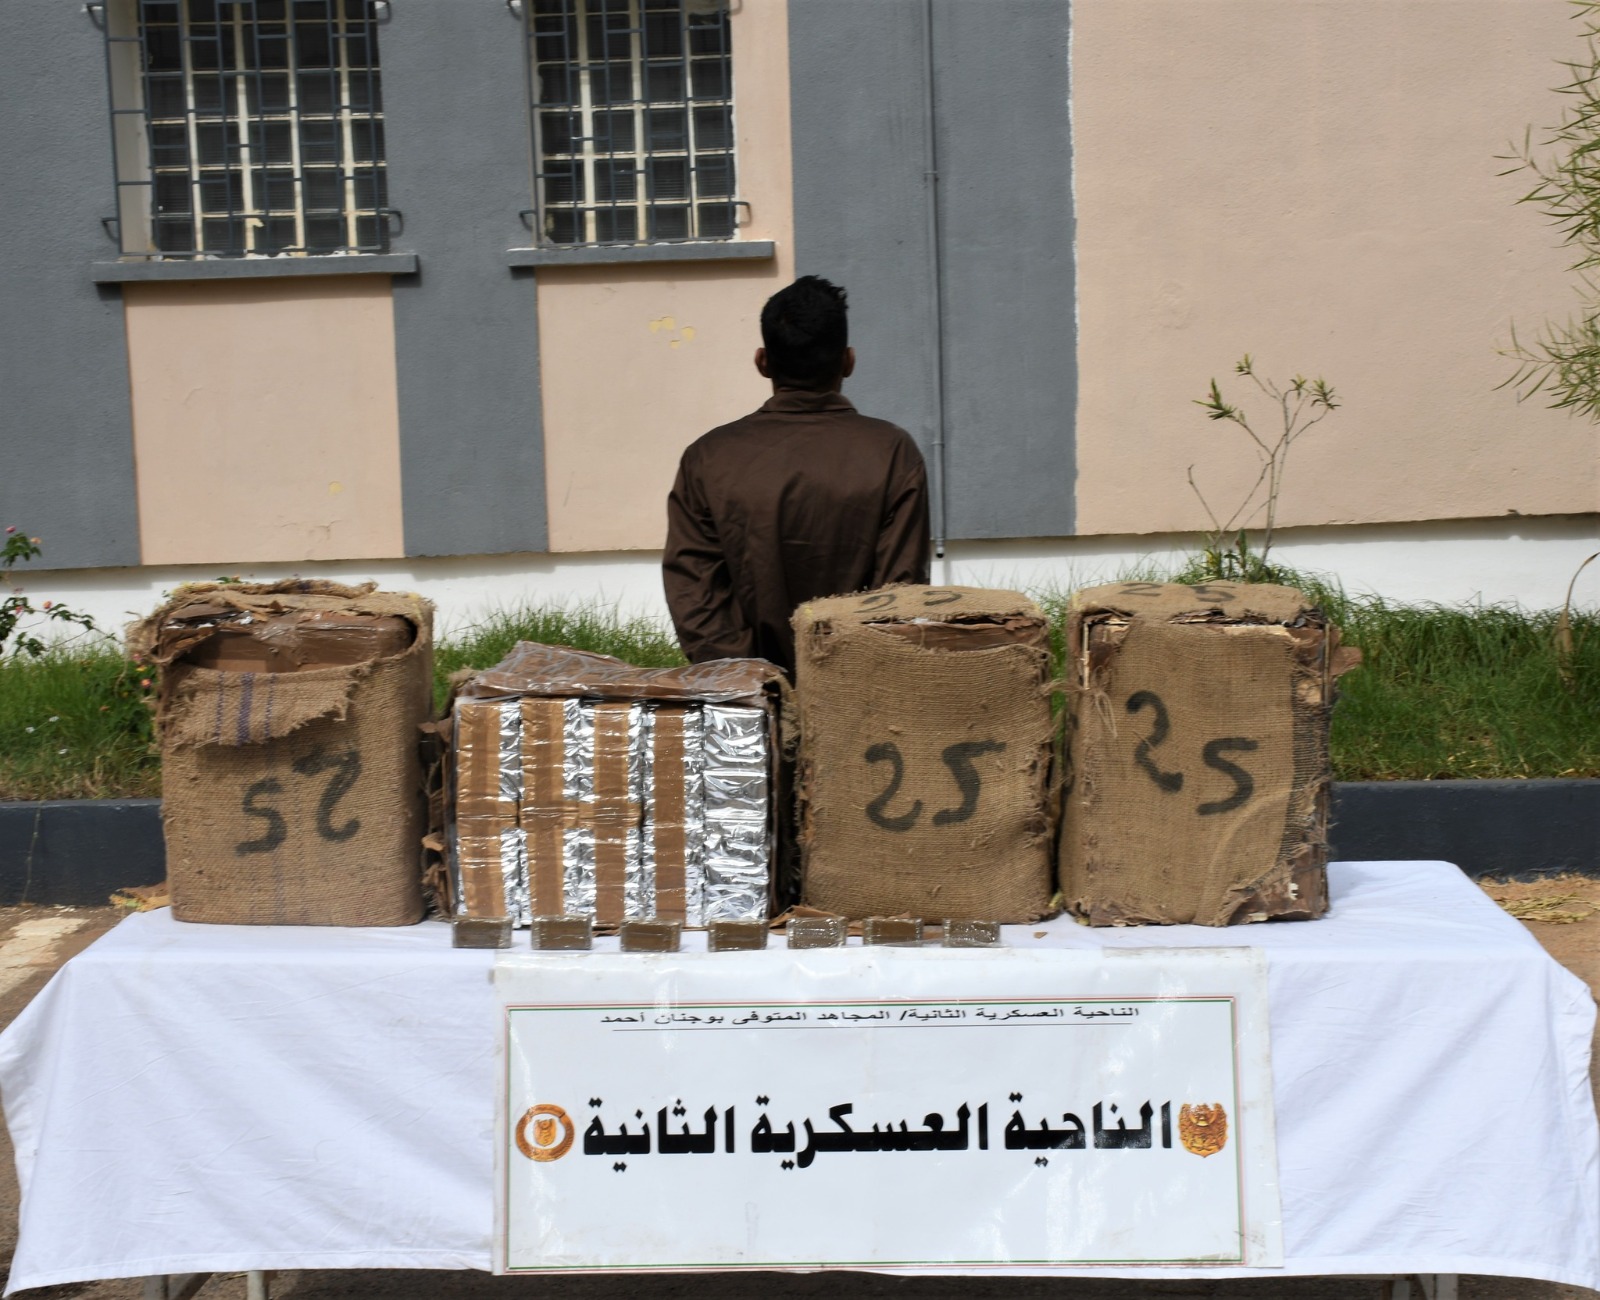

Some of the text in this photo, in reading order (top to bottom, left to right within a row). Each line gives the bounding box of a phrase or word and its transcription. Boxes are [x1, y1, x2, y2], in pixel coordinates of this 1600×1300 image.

[815, 1010, 891, 1021] المجاهد
[975, 1008, 1065, 1022] العسكرية
[1073, 1007, 1140, 1020] الناحية
[583, 1097, 735, 1173] الثانية
[751, 1095, 990, 1170] العسكرية
[1004, 1092, 1172, 1167] الناحية
